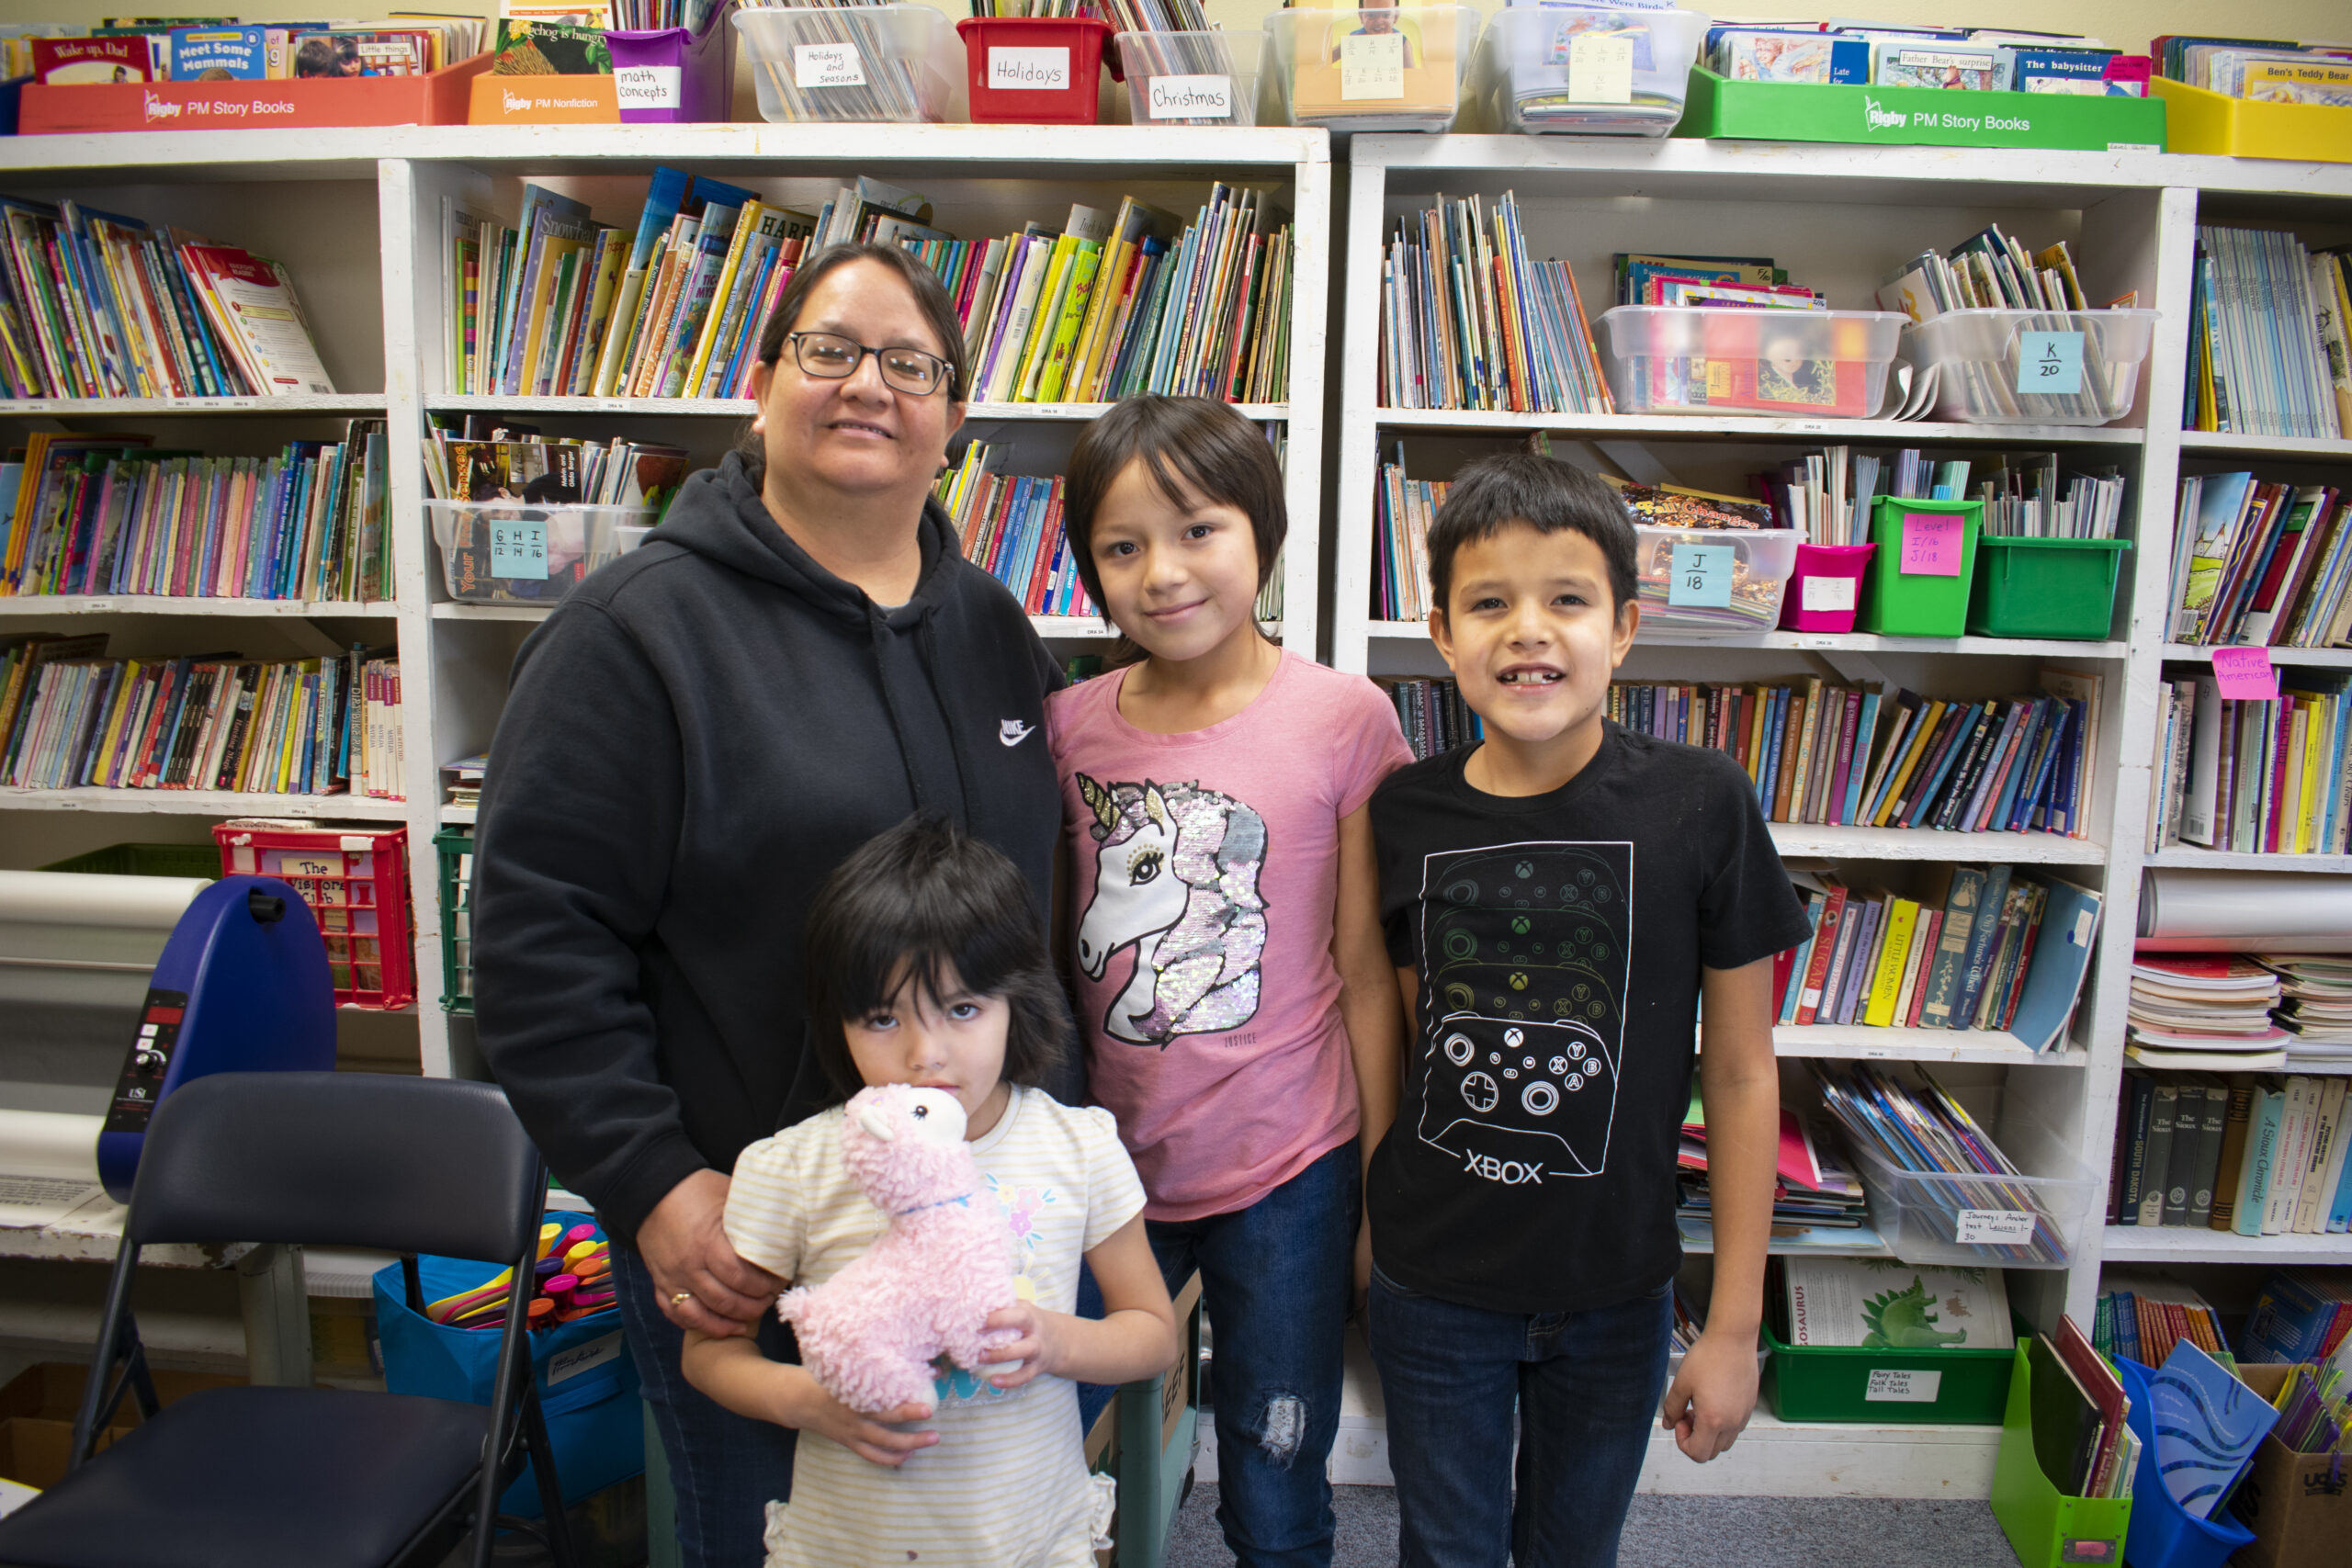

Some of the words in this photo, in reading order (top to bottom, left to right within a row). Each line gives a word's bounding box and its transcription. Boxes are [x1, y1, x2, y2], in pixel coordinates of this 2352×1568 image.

[1637, 2, 1665, 10] Birds
[561, 28, 570, 39] is
[54, 45, 85, 59] Wake
[106, 42, 129, 58] Dad
[179, 44, 210, 59] Meet
[213, 42, 253, 57] Some
[361, 45, 381, 54] Little
[385, 45, 409, 56] things
[808, 51, 843, 63] Holidays
[182, 57, 250, 72] Mammals
[826, 61, 844, 71] and
[1902, 54, 1927, 63] Father
[1959, 59, 1990, 69] surprise
[2026, 61, 2045, 69] The
[2052, 62, 2102, 73] babysitter
[620, 71, 656, 83] math
[997, 61, 1061, 85] Holidays
[1834, 67, 1849, 75] Late
[2267, 68, 2292, 77] Ben's
[2298, 69, 2324, 80] Teddy
[2328, 71, 2349, 80] Bear
[536, 98, 551, 108] PM
[553, 98, 598, 108] Nonfiction
[1153, 85, 1225, 107] Christmas
[148, 103, 182, 118] Rigby
[187, 102, 209, 115] PM
[213, 101, 248, 117] Story
[253, 100, 295, 114] Books
[1870, 110, 1906, 128] Rigby
[1914, 113, 1938, 126] PM
[1942, 114, 1980, 131] Story
[1985, 116, 2030, 130] Books
[1644, 268, 1668, 276] Daniel
[2048, 341, 2056, 357] K
[2040, 365, 2059, 377] 20
[1001, 500, 1010, 517] BEVERLY
[1635, 501, 1677, 515] Fall
[1681, 502, 1759, 530] Changes
[998, 518, 1006, 535] CLEARY
[1915, 518, 1950, 532] Level
[514, 531, 522, 541] H
[495, 547, 504, 557] 12
[532, 549, 542, 558] 16
[1693, 554, 1707, 568] J
[1687, 576, 1703, 590] 18
[2222, 649, 2266, 669] Native
[2217, 670, 2275, 683] American
[352, 687, 360, 708] DIRT
[1001, 719, 1023, 735] NIKE
[1845, 709, 1855, 736] CHASING
[2277, 710, 2291, 765] TALLCHIEF
[351, 739, 360, 756] RA
[1840, 737, 1850, 763] REDBIRD
[1766, 766, 1776, 795] MOUNTAIN
[2344, 779, 2352, 806] Clears
[300, 862, 328, 875] The
[290, 877, 345, 892] Visiors
[301, 892, 334, 905] Clb
[1889, 932, 1905, 964] LITTLE
[1971, 927, 1991, 965] Fortune's
[1808, 936, 1831, 987] SUGAR
[1882, 964, 1899, 1000] WOMEN
[1964, 964, 1982, 994] Wheel
[1824, 971, 1838, 1010] YEARLING
[1225, 1032, 1257, 1048] JUSTICE
[2152, 1124, 2172, 1133] Sioux
[2176, 1121, 2196, 1129] Sioux
[2201, 1123, 2222, 1132] Sioux
[2258, 1127, 2274, 1158] Sioux
[2132, 1139, 2143, 1168] SOUTH
[1464, 1148, 1544, 1184] XBOX
[2127, 1169, 2140, 1204] DAKOTA
[2251, 1158, 2268, 1204] Chronicle
[1794, 1286, 1808, 1347] OSAURUS
[1894, 1371, 1911, 1380] Tales
[1888, 1387, 1910, 1395] Tales
